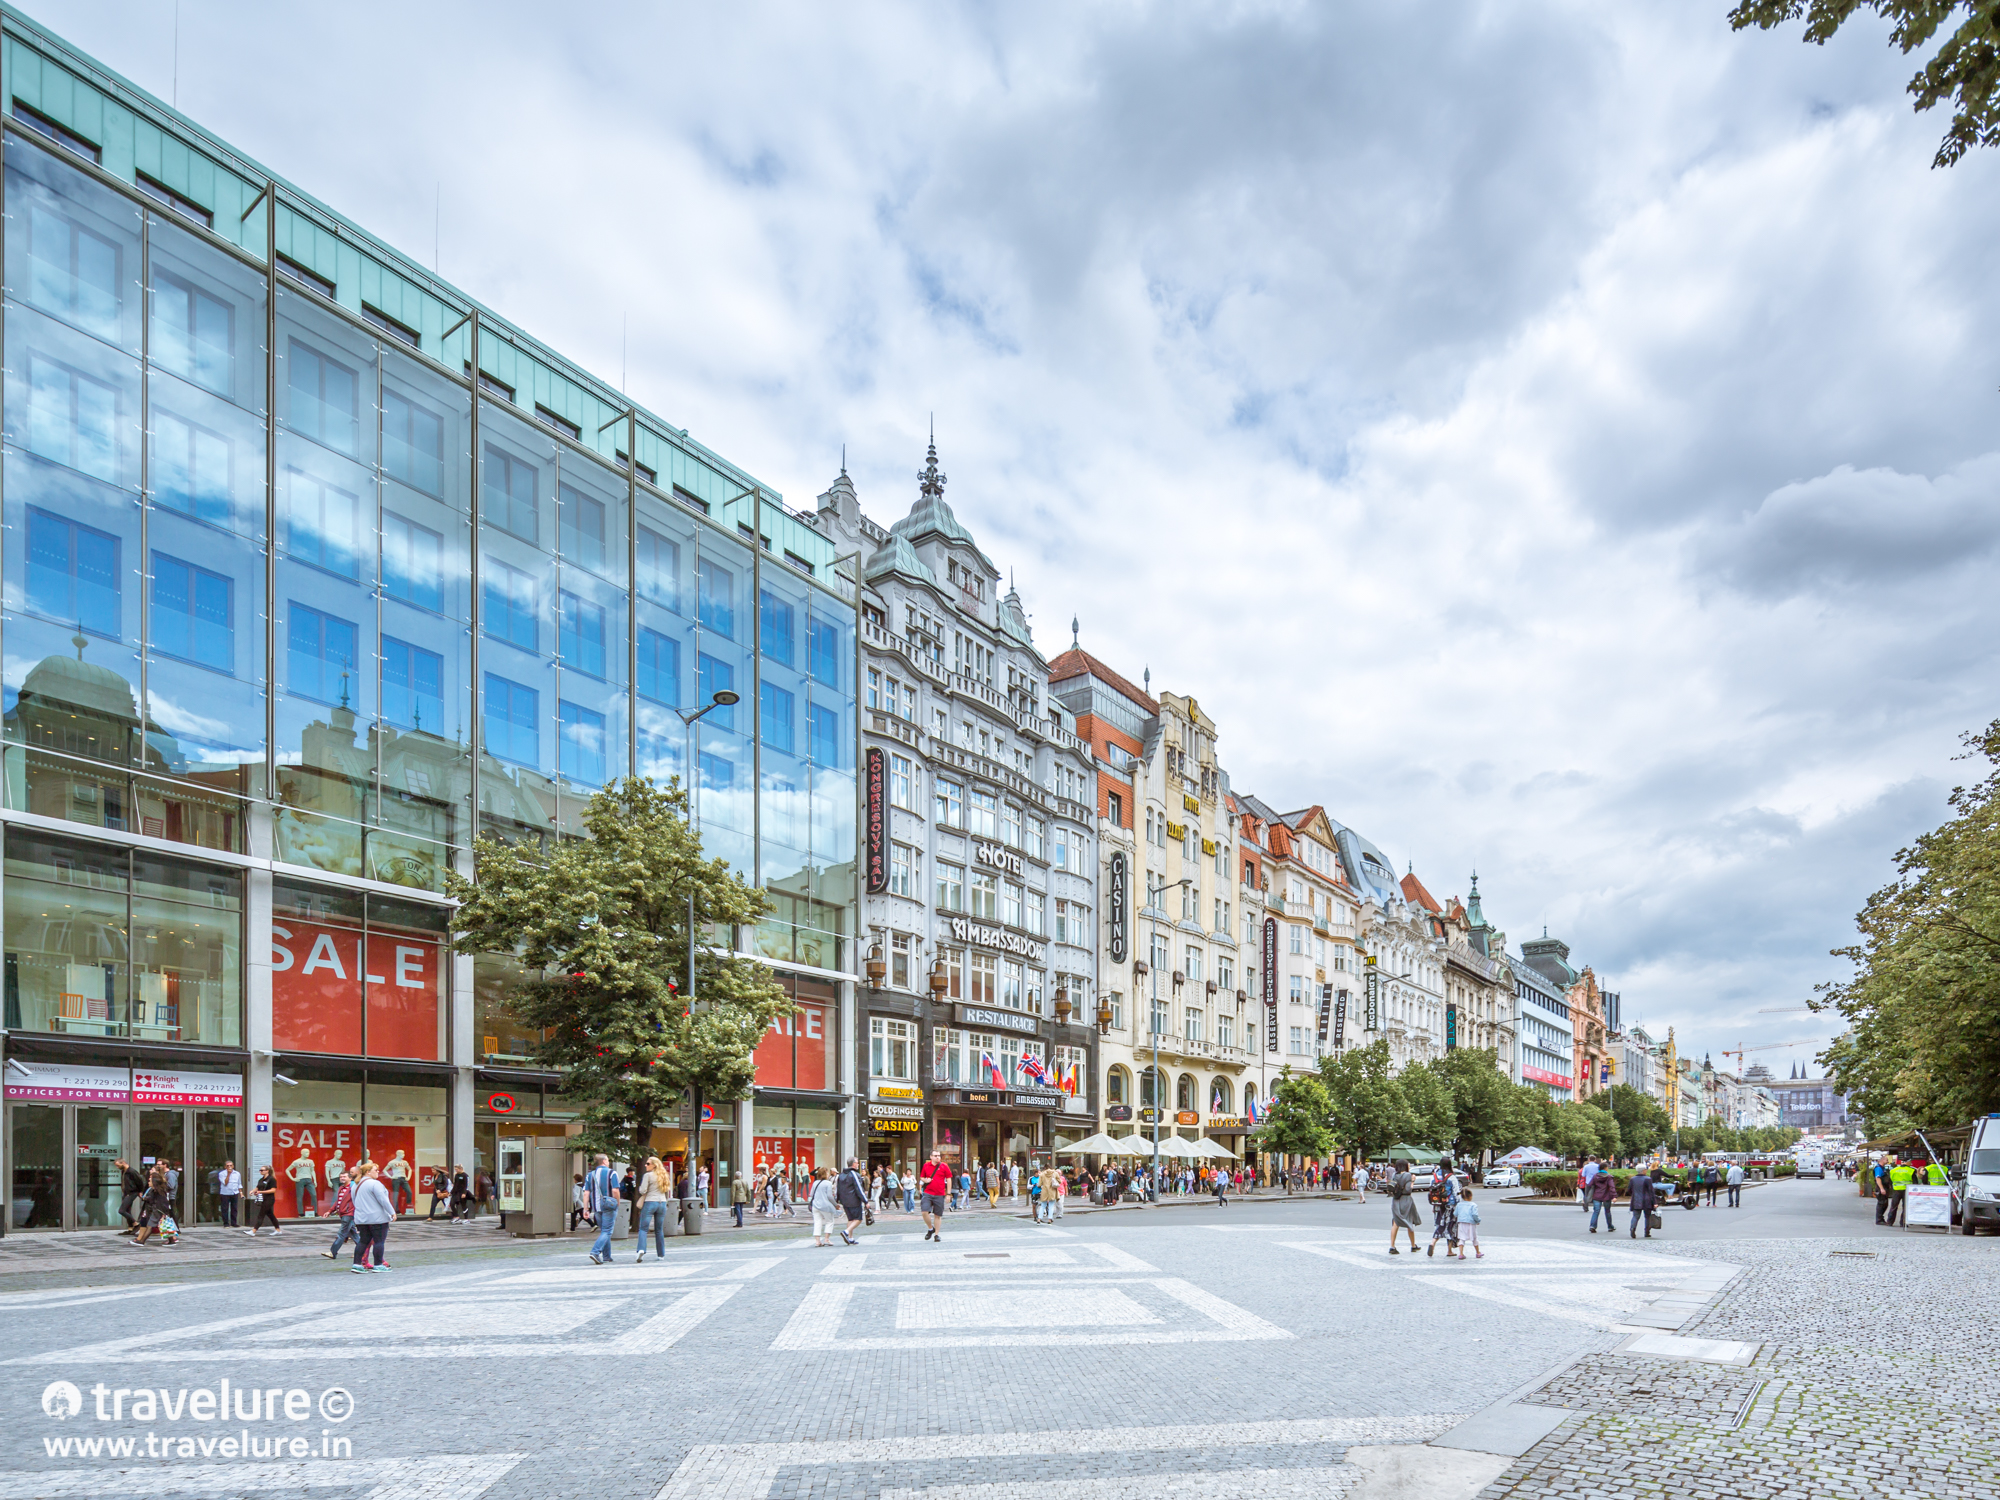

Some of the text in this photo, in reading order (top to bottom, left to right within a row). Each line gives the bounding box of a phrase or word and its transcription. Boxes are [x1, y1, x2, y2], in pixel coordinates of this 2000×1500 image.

[978, 841, 1025, 878] HOTEL
[1113, 859, 1122, 954] CASINO
[952, 918, 1043, 959] AMBASSADOR
[272, 925, 425, 989] SALE
[1266, 970, 1274, 1003] CENTRUM
[766, 1008, 822, 1039] ALE
[966, 1008, 1035, 1032] RESTAURACE
[1336, 996, 1345, 1038] RESERVED
[1447, 1011, 1455, 1045] GATE
[153, 1075, 179, 1083] Knight
[9, 1088, 61, 1096] OFFICES
[970, 1093, 988, 1101] hotel
[871, 1106, 923, 1116] GOLDFINGERS
[278, 1128, 350, 1148] SALE
[875, 1120, 919, 1132] CASINO
[755, 1141, 782, 1154] ALE
[421, 1175, 434, 1186] -5
